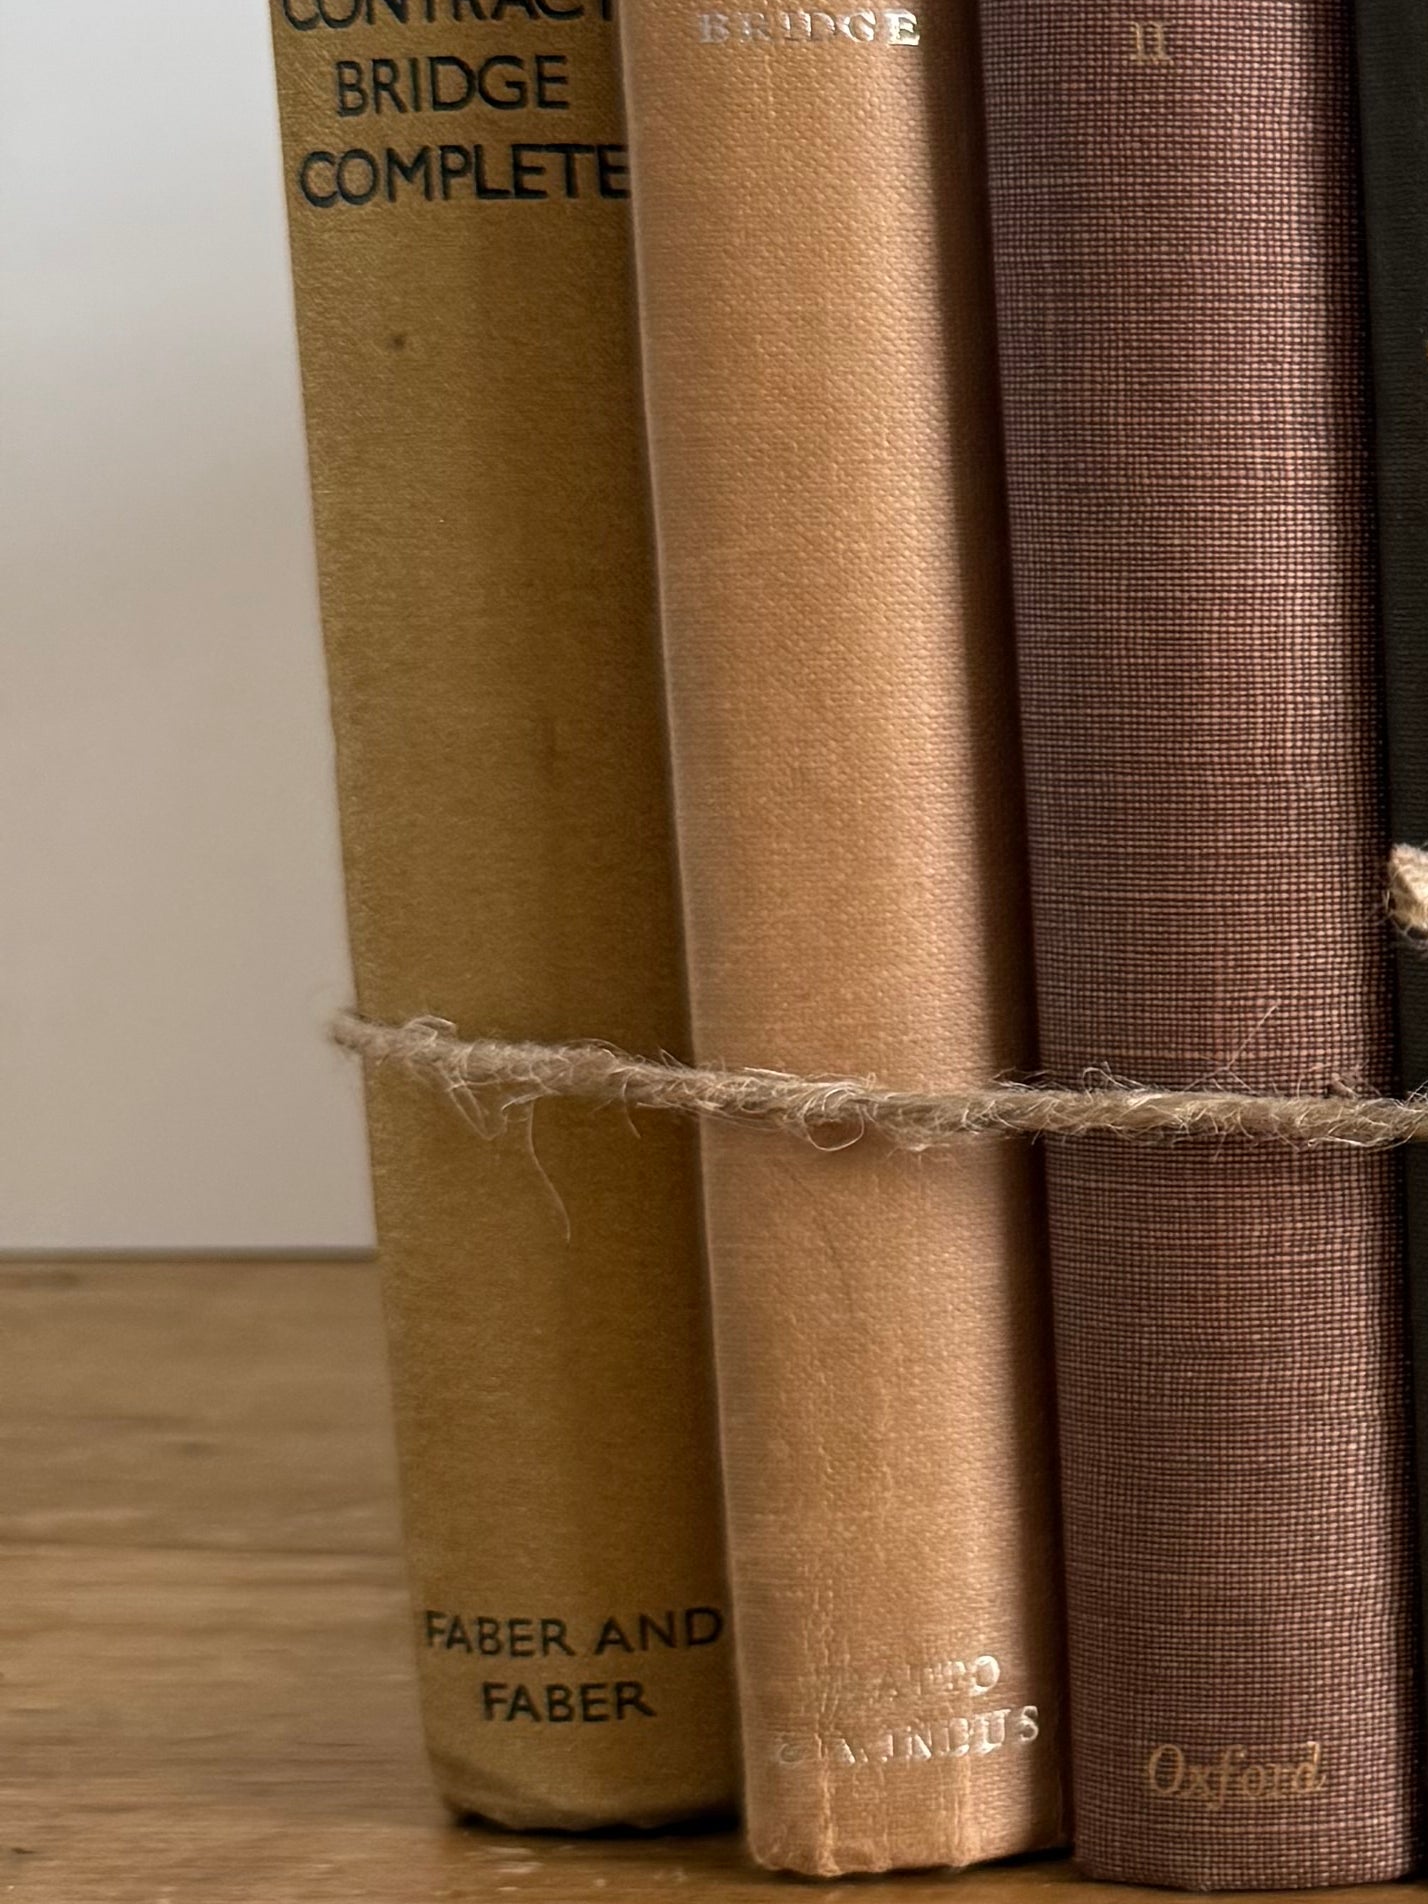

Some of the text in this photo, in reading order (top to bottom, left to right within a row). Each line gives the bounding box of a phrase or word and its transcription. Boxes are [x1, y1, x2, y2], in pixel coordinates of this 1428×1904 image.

[699, 8, 920, 47] BRIDGE
[1129, 20, 1173, 64] II
[336, 53, 569, 119] BRIDGE
[300, 142, 630, 209] COMPLETE
[424, 1604, 724, 1659] FABER AND
[480, 1679, 657, 1724] FABER
[1143, 1740, 1329, 1812] Oxford
